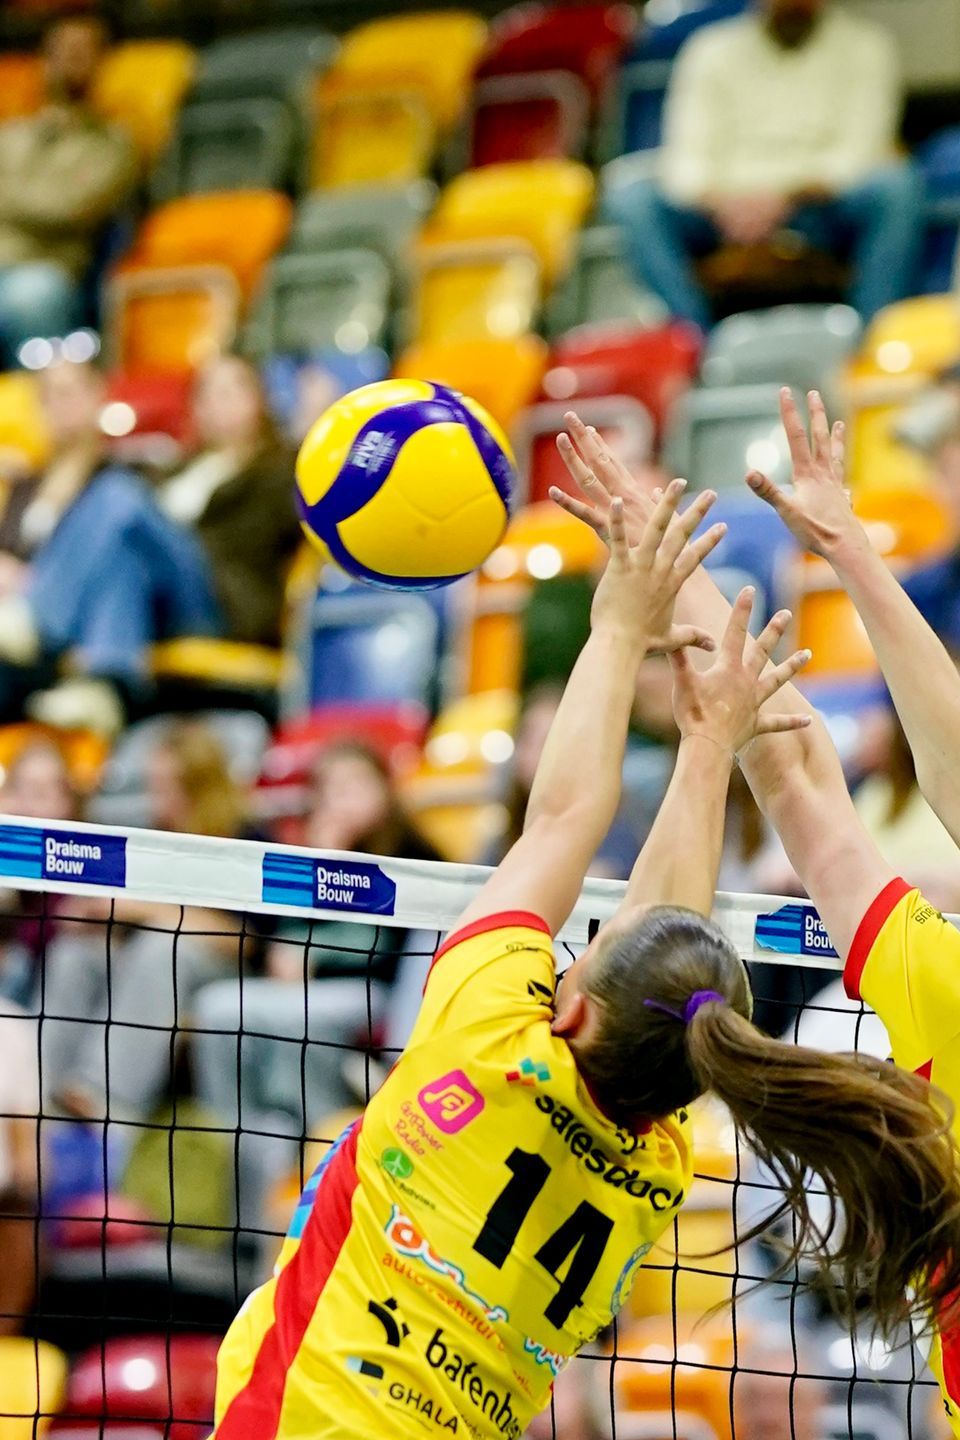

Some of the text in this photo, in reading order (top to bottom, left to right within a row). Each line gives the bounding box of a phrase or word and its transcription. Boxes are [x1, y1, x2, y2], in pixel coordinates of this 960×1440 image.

[45, 836, 102, 861] Draisma
[45, 855, 85, 876] Bouw
[316, 866, 371, 890] Draisma
[316, 883, 355, 905] Bouw
[804, 914, 829, 934] Dra
[472, 1147, 615, 1330] 14
[388, 1382, 459, 1435] GHALA
